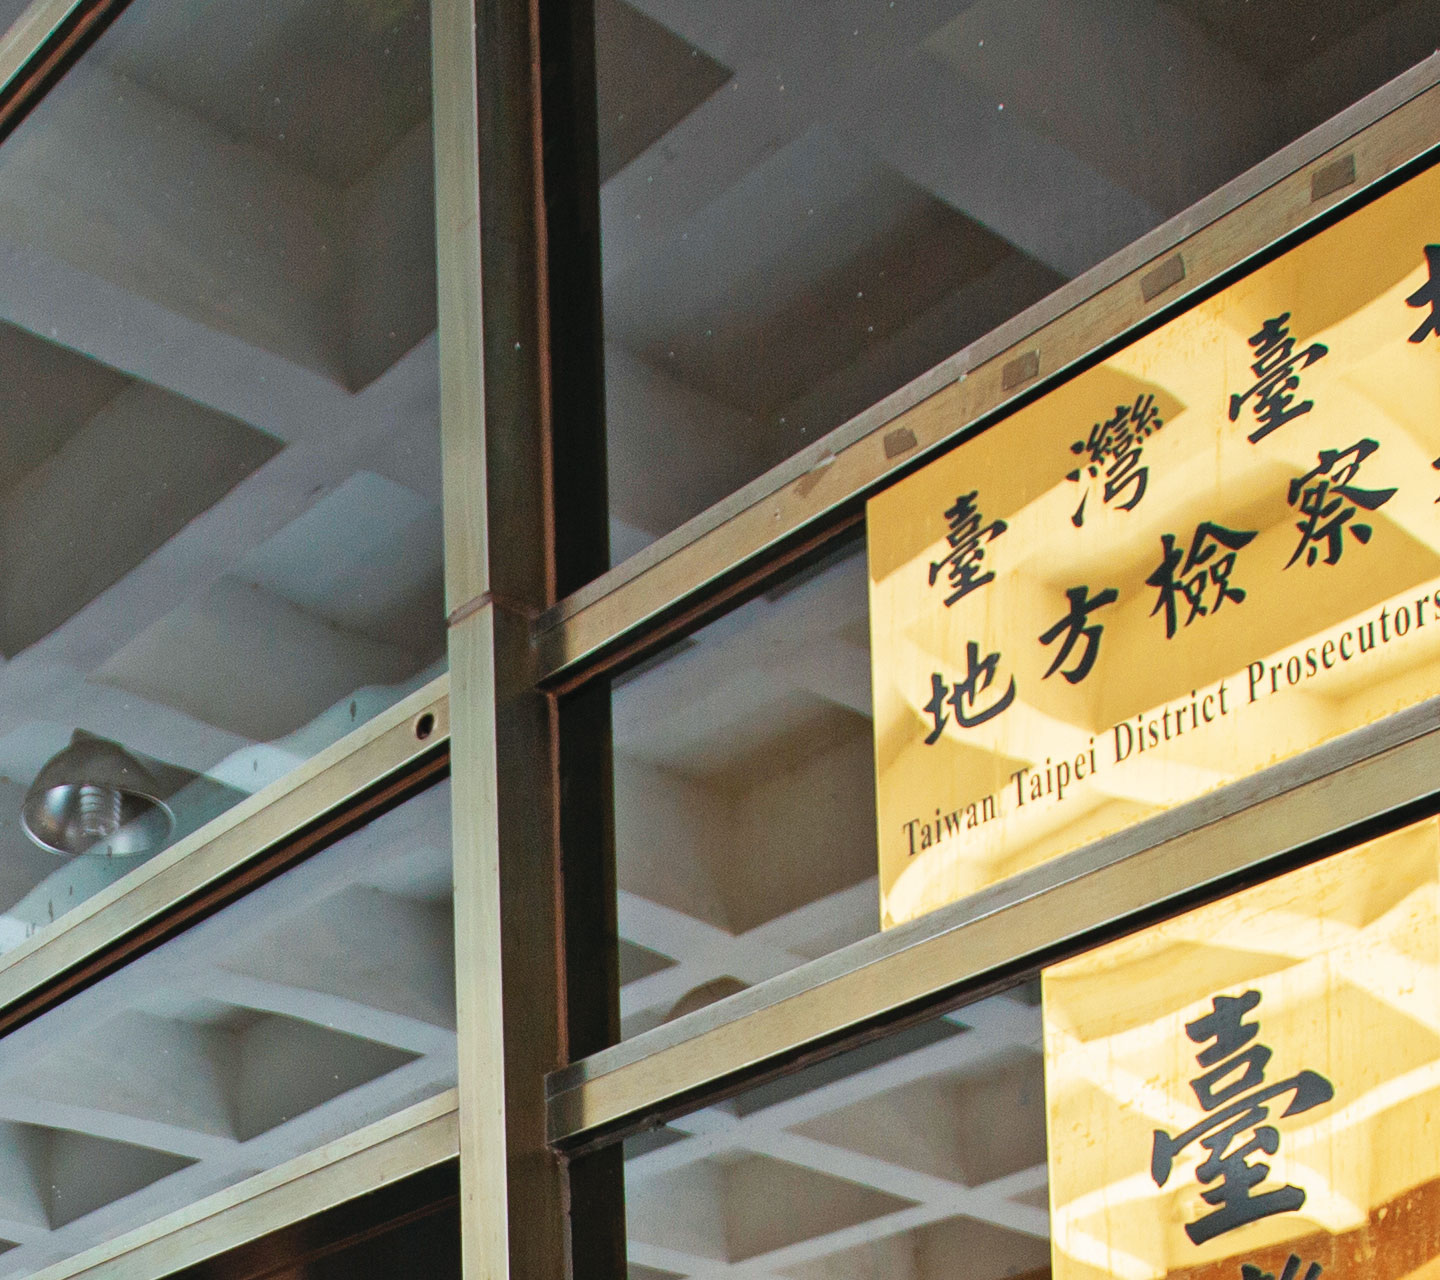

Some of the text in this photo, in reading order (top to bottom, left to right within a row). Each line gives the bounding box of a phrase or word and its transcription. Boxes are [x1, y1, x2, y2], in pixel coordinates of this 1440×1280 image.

[903, 797, 997, 857] Taiwan
[1010, 739, 1098, 806] Taipei
[1113, 682, 1229, 764] District
